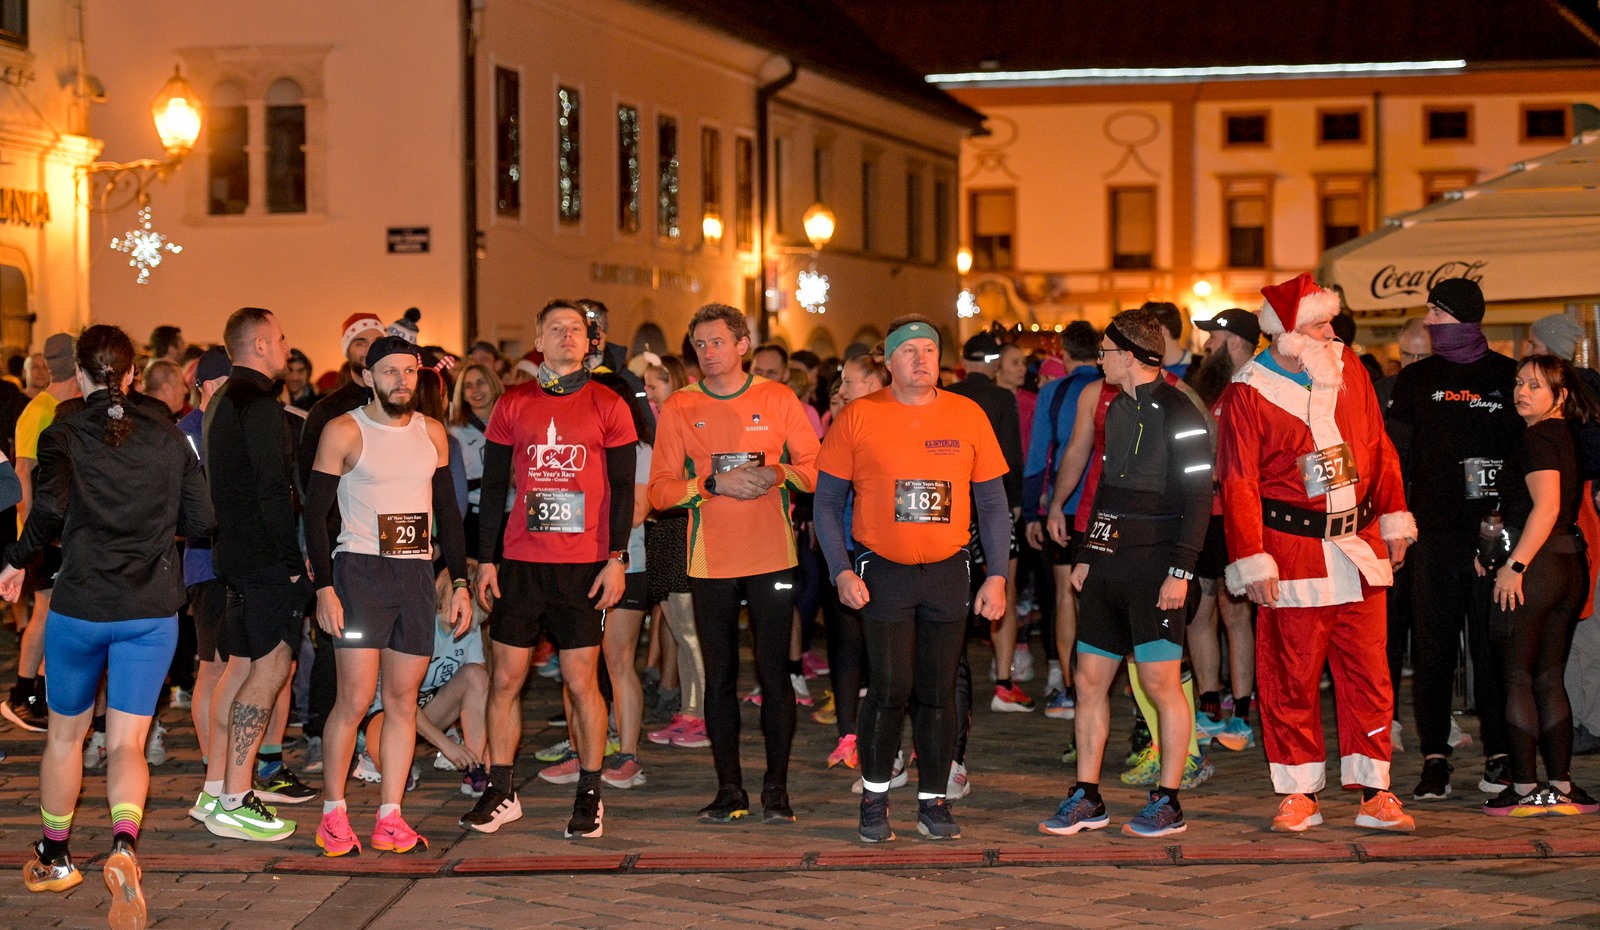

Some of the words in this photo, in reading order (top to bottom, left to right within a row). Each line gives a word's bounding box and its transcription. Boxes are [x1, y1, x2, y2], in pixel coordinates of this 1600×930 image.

[1469, 397, 1503, 413] Change
[1312, 457, 1344, 483] 257
[907, 491, 942, 511] 182
[538, 502, 572, 521] 328
[395, 525, 416, 544] 29
[1090, 521, 1112, 541] 274
[454, 648, 465, 657] 23
